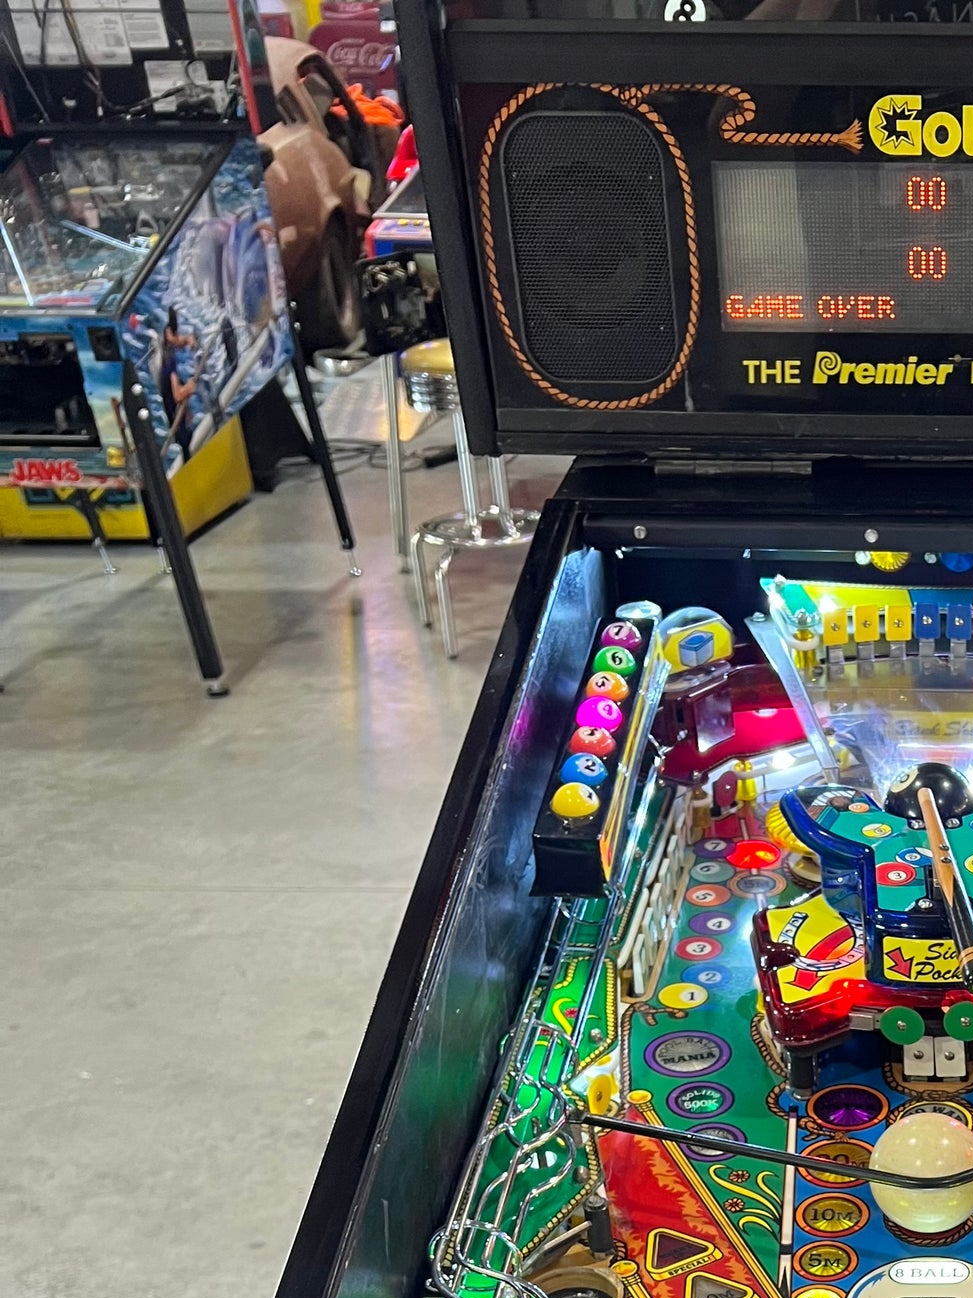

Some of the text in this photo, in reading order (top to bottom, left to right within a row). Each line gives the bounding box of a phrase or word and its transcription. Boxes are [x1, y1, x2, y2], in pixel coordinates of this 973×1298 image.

[907, 176, 947, 211] 00
[908, 246, 947, 280] 00
[726, 294, 897, 320] GAME OVER
[743, 360, 802, 385] THE
[812, 351, 954, 386] Premier
[10, 458, 84, 483] JAWS
[611, 651, 623, 665] 6
[584, 758, 597, 772] 2
[710, 842, 720, 850] 7
[700, 864, 712, 873] 6
[696, 892, 713, 900] 5
[712, 919, 723, 929] 4
[692, 944, 706, 954] 3
[704, 972, 717, 983] 2
[914, 961, 964, 981] Pock
[688, 991, 696, 1001] 1
[661, 1051, 717, 1065] MANIA
[681, 1089, 722, 1102] SOLIDS
[810, 1207, 854, 1222] 10M
[808, 1253, 842, 1268] 5M
[895, 1267, 965, 1279] 8 BALL
